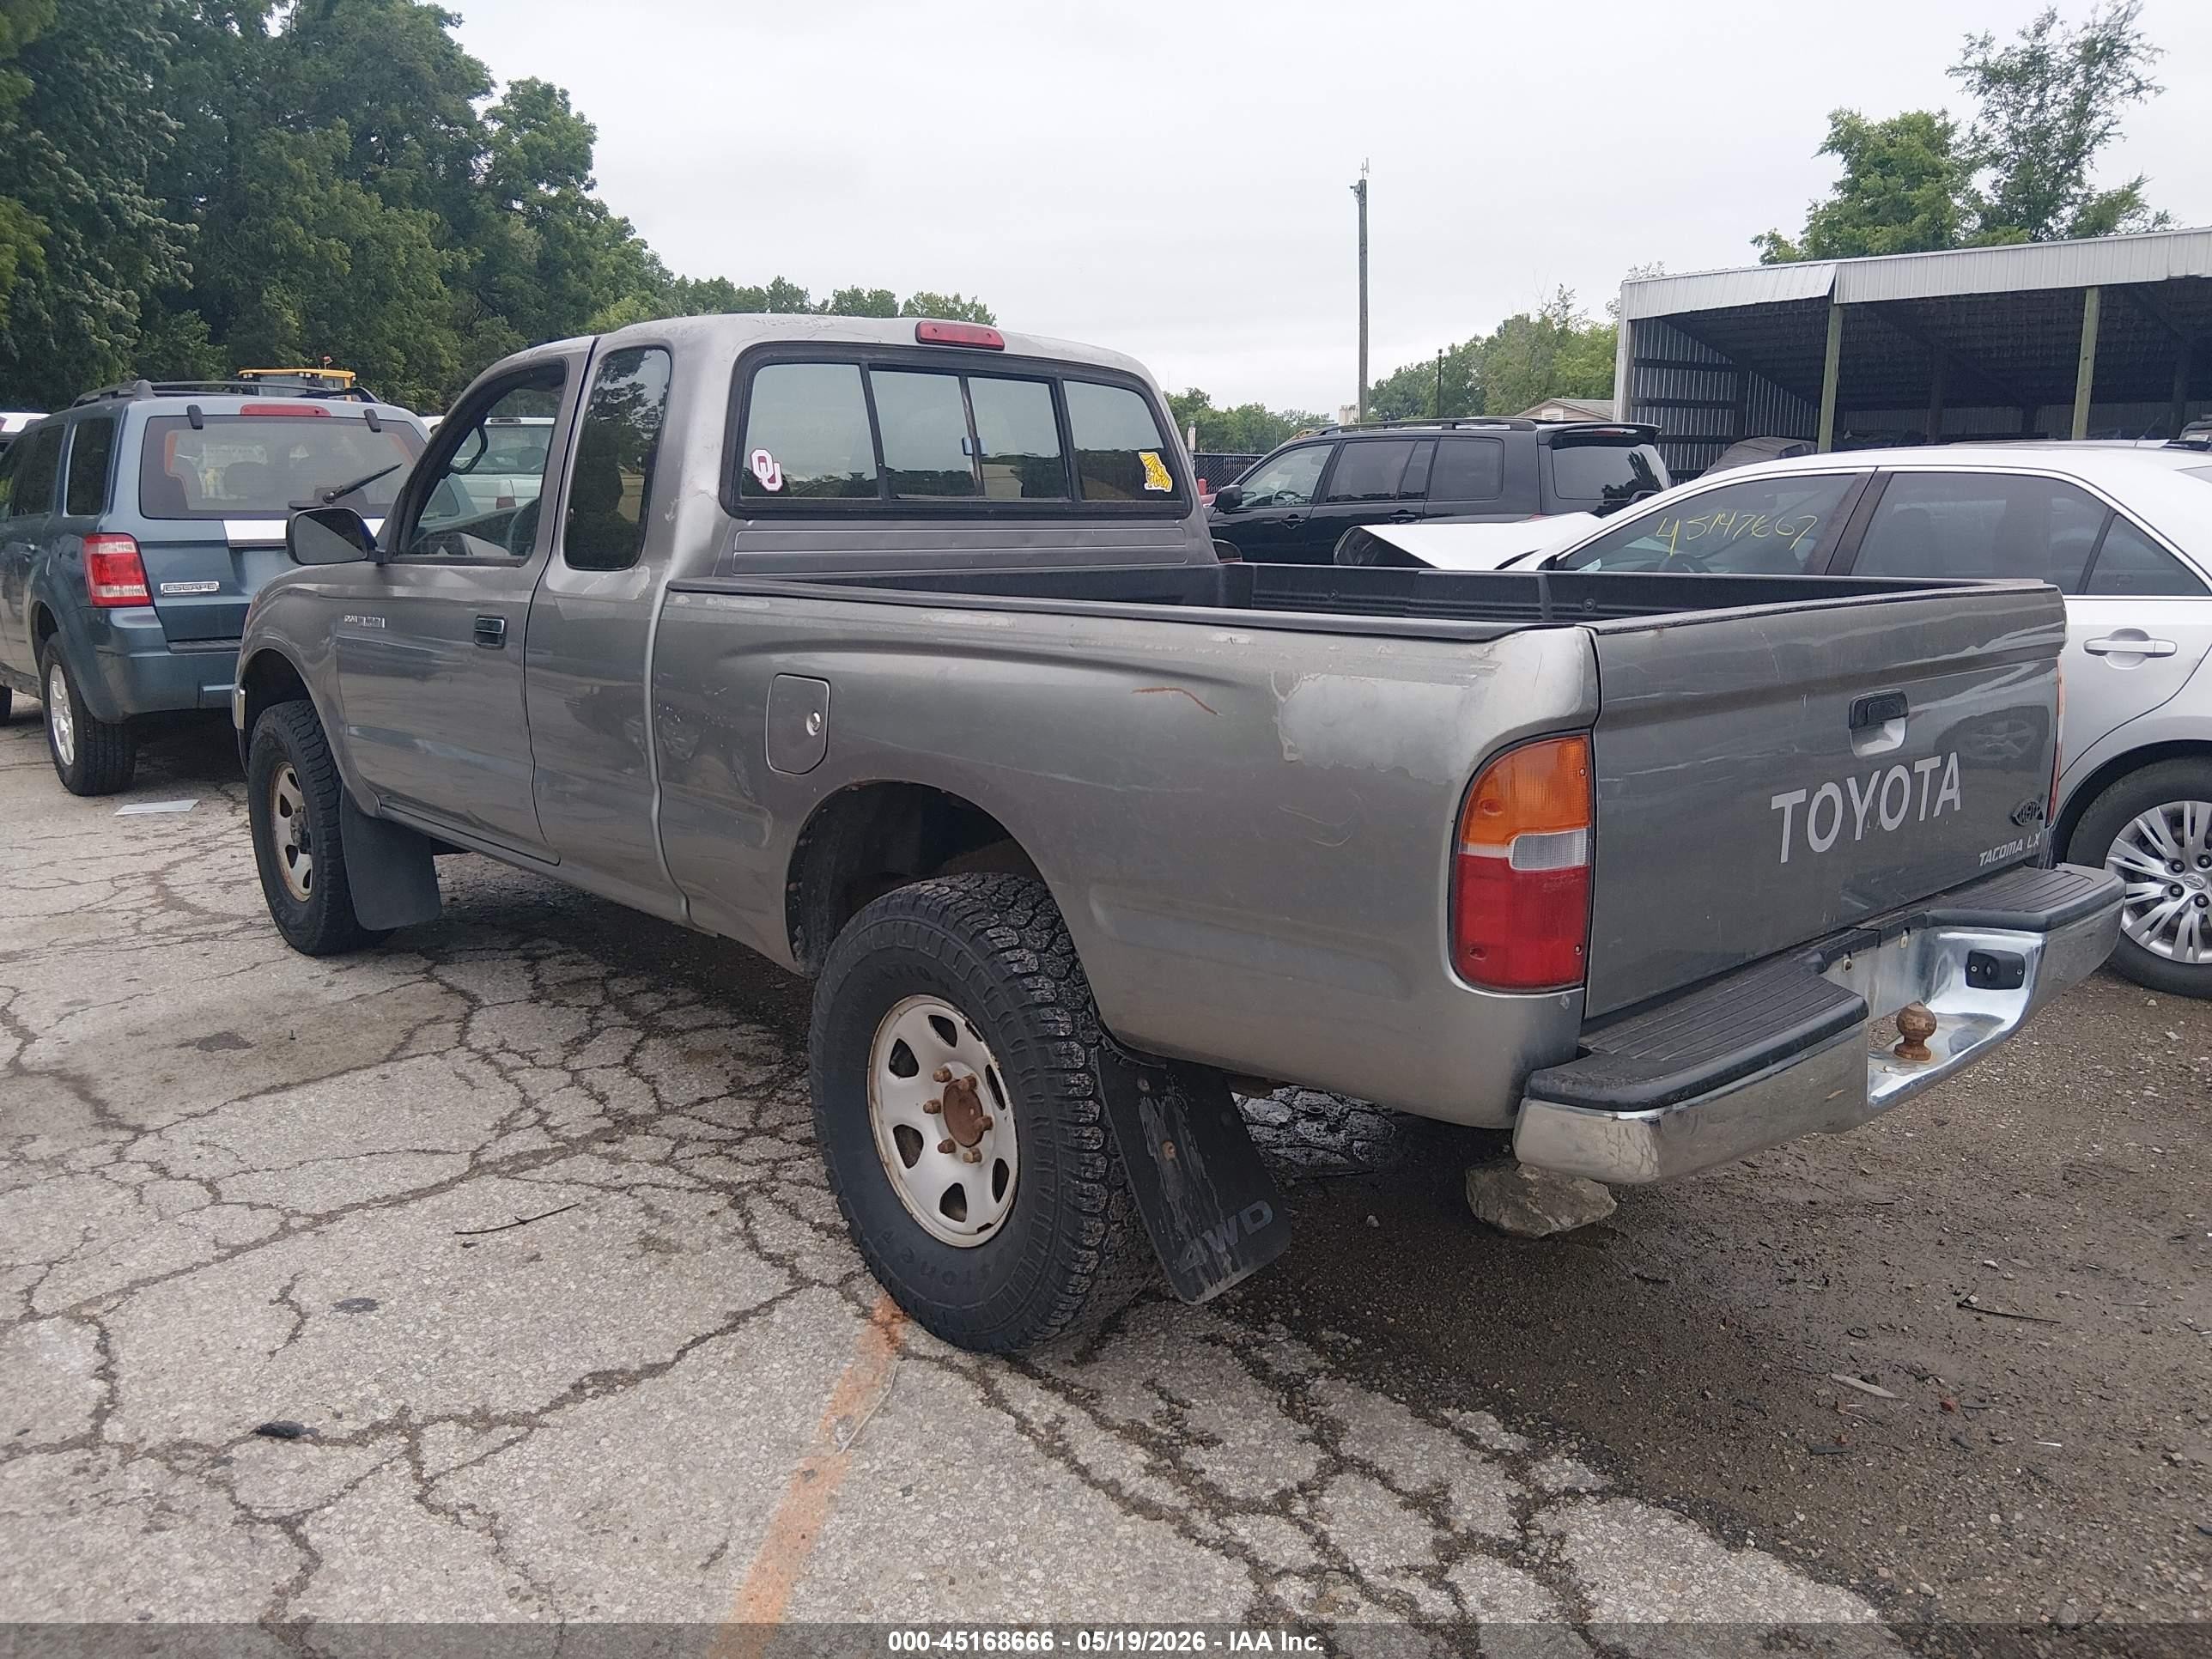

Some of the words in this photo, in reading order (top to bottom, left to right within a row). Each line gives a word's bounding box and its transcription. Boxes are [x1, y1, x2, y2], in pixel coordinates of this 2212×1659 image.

[750, 448, 782, 491] OU
[1656, 511, 1818, 556] 45147667
[162, 582, 218, 592] ESCAPE
[1771, 751, 1961, 864] TOYOTA
[1979, 838, 2023, 866] TACOMA
[2027, 831, 2041, 849] LX
[1179, 1200, 1273, 1274] 4WD
